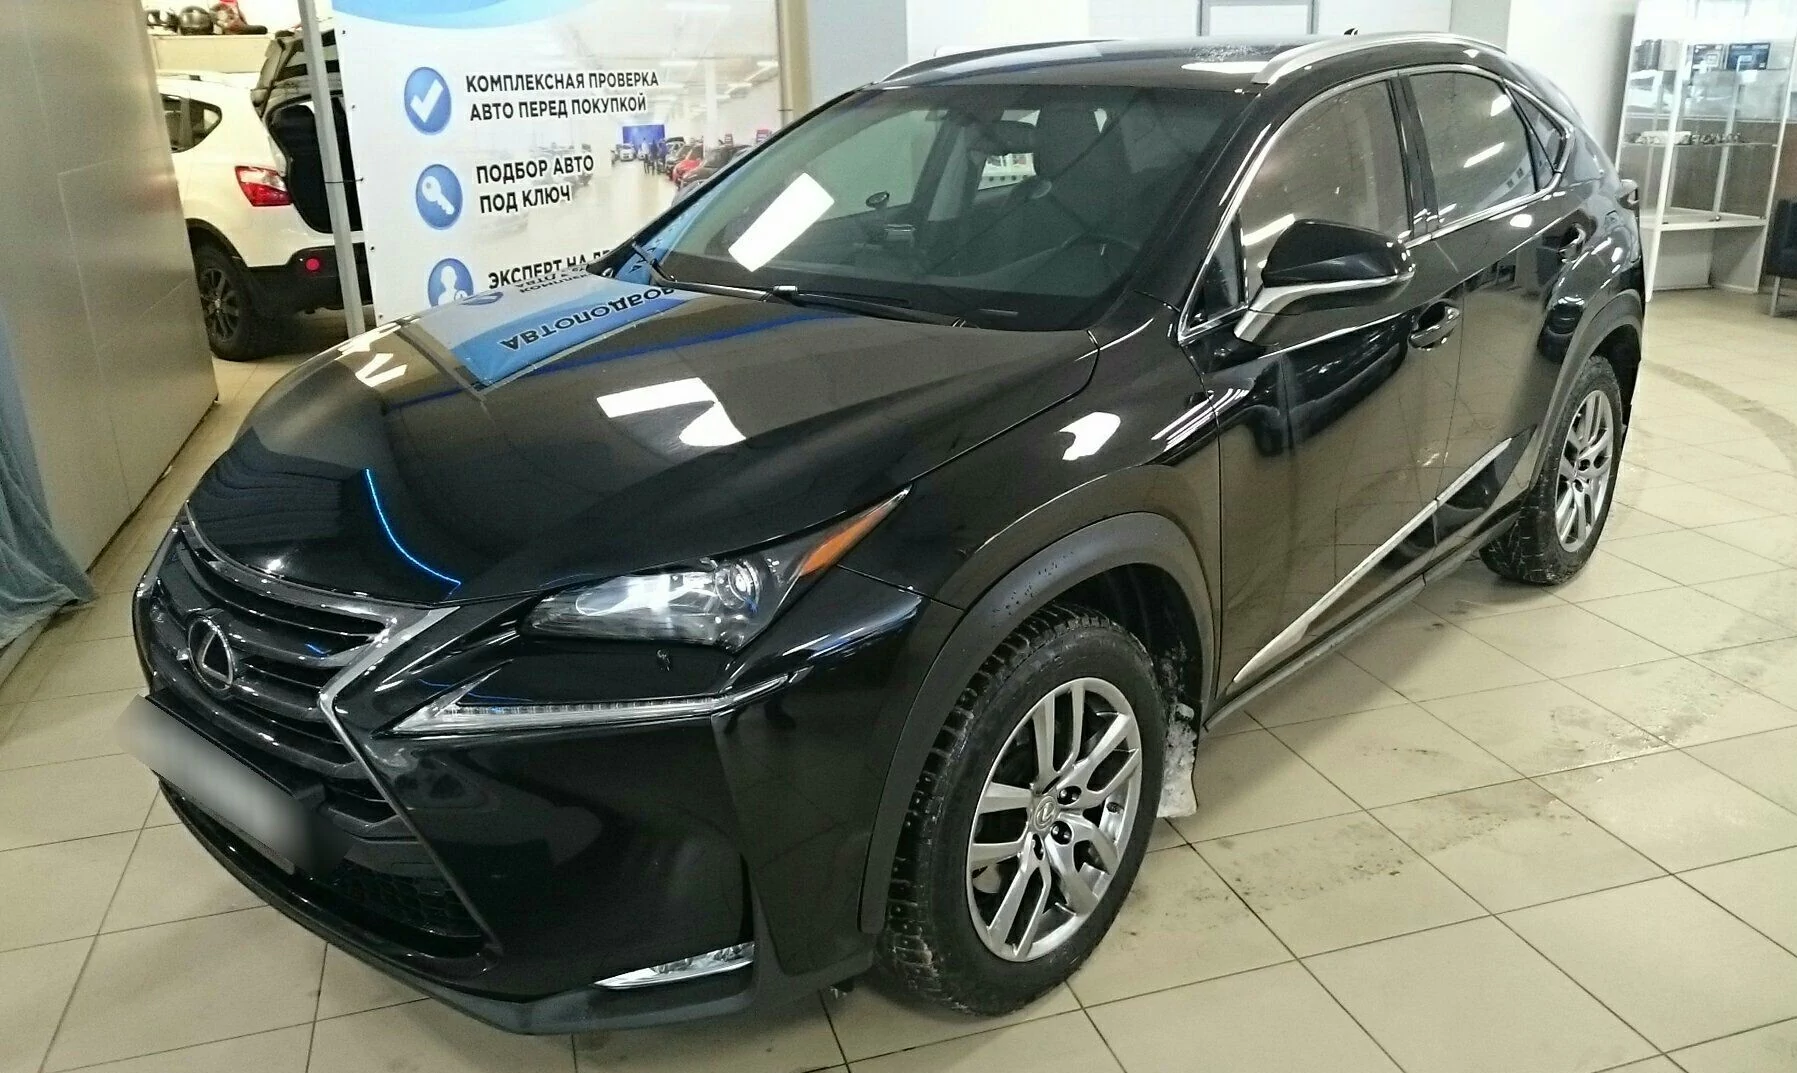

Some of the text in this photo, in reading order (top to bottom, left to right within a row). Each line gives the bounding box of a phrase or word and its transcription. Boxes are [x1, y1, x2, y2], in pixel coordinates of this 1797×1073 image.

[465, 71, 659, 93] КОМПЛЕКСНАЯ ПРОВЕРКА
[470, 92, 647, 121] АВТО ПЕРЕД ПОКУПКОЙ
[476, 155, 594, 184] ПОДБОР АВТО
[480, 185, 571, 214] ПОД КЛЮЧ
[488, 259, 562, 289] ЭКСПЕРТ
